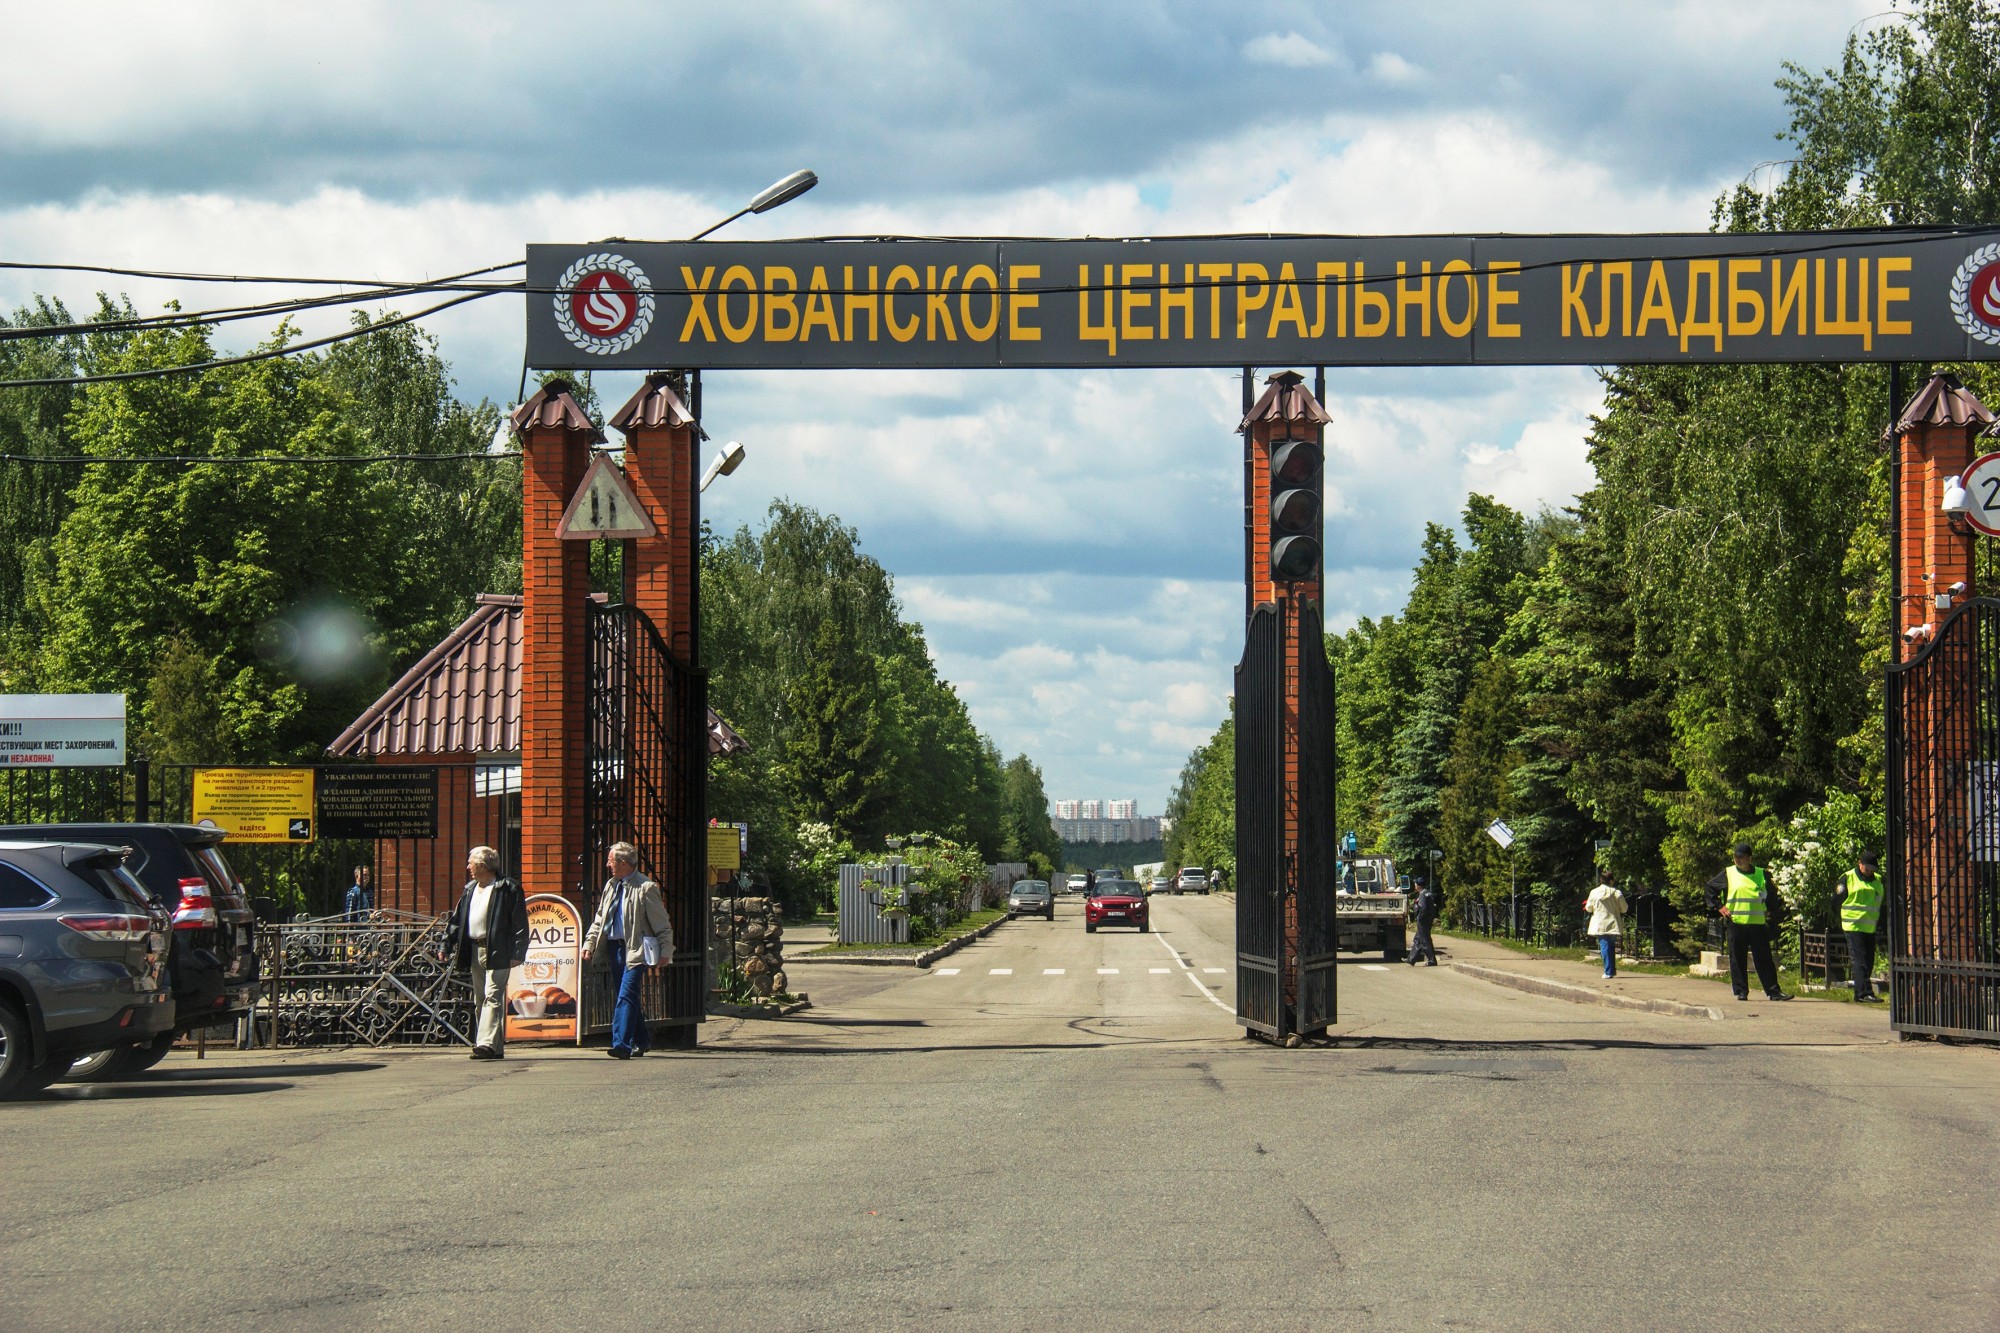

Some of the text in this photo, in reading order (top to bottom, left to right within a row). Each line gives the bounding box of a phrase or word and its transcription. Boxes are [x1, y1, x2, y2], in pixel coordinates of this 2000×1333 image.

[679, 256, 1913, 357] ХОВАНСКОЕ ЦЕНТРАЛЬНОЕ КЛАДБИЩЕ
[0, 739, 118, 752] СТВУЮЩИХ МЕСТ ЗАХОРОНЕНИЙ,
[10, 754, 54, 763] НЕЗАКОННА!
[1389, 900, 1400, 908] 90
[528, 926, 575, 945] АФЕ
